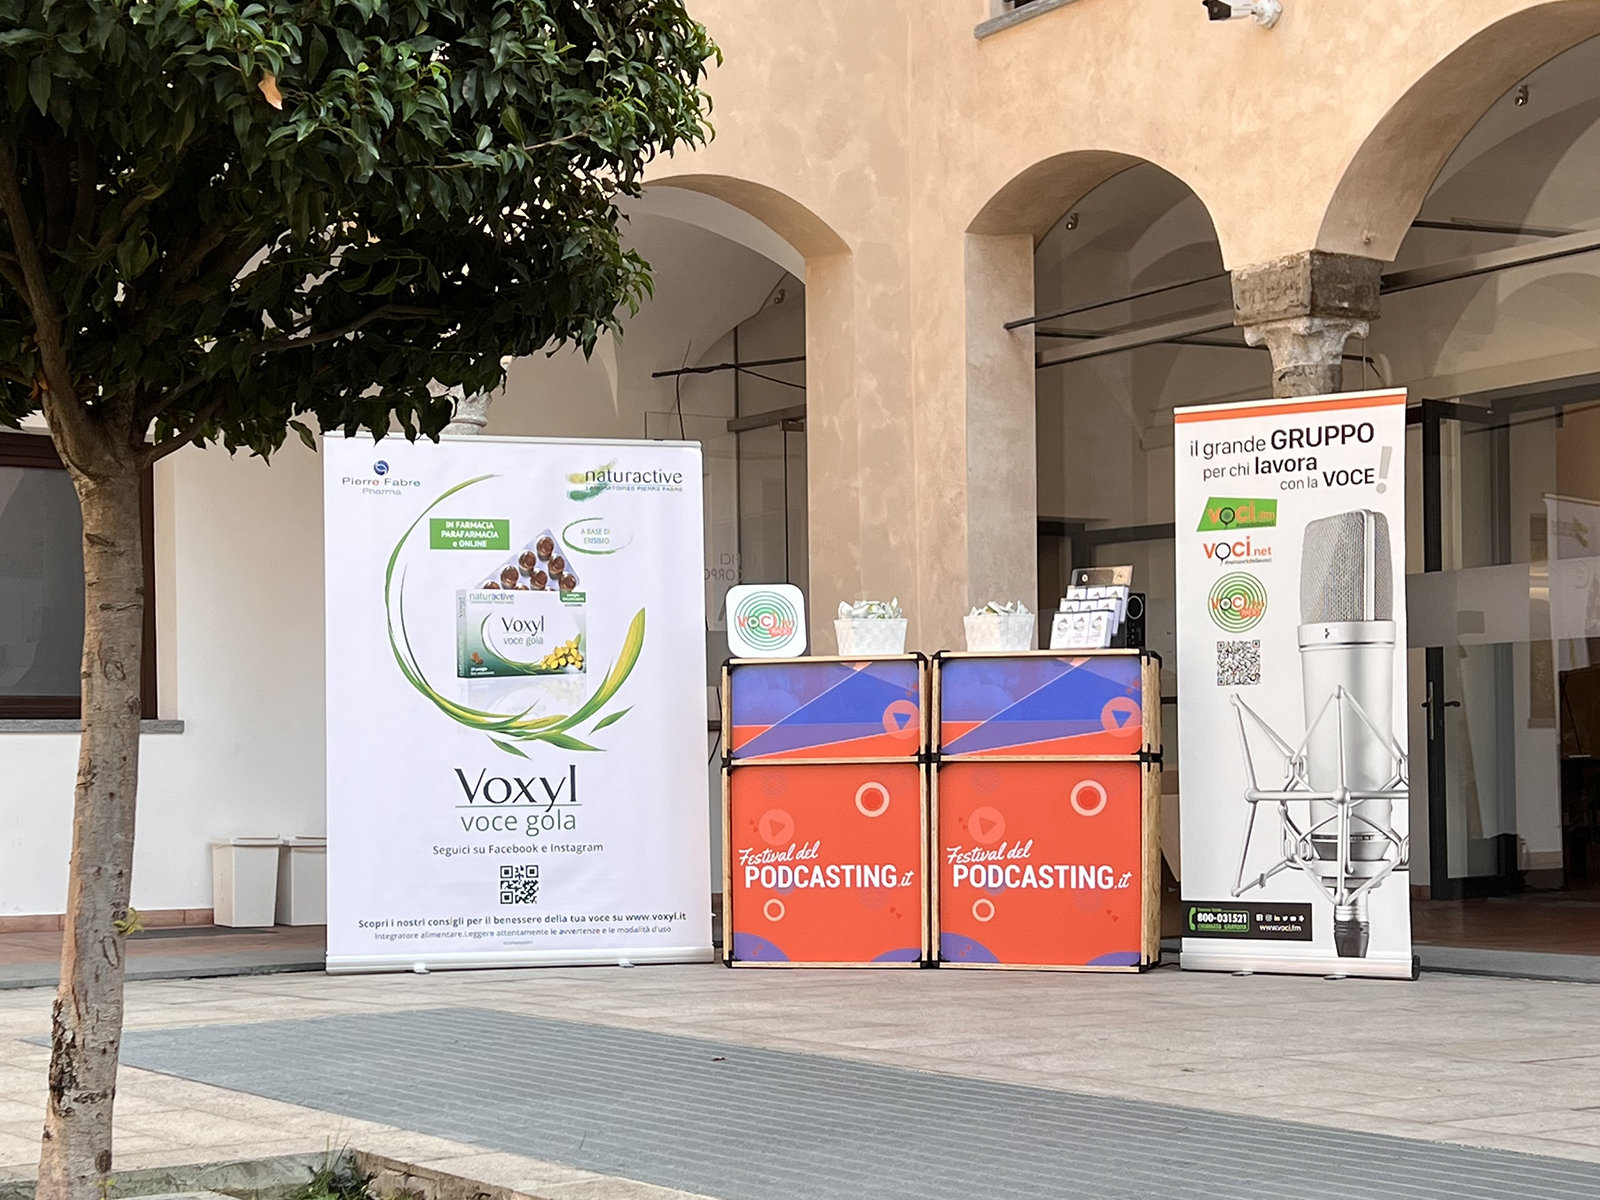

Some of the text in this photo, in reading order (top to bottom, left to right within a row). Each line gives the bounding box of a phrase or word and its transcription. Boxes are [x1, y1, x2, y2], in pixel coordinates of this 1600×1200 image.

[1190, 422, 1374, 460] il grande GRUPPO
[585, 468, 683, 484] naturactive
[1203, 456, 1317, 481] per chi lavora
[342, 477, 421, 487] Pierre Fabre
[1280, 478, 1304, 490] con
[1307, 476, 1318, 489] la
[362, 487, 402, 496] Pharma
[446, 521, 494, 530] IN FARMACIA
[441, 530, 499, 539] PARAFARMACIA
[459, 540, 487, 548] ONLINE
[469, 592, 515, 600] naturactive
[501, 615, 544, 636] Voxyl
[503, 636, 544, 647] voce gola
[454, 764, 577, 813] Voxyl
[461, 809, 576, 837] voce gola
[433, 845, 471, 857] Seguici
[473, 846, 485, 854] su
[489, 843, 539, 854] Facebook
[550, 843, 604, 855] Instagram
[738, 840, 821, 866] Festival del
[946, 839, 1034, 865] Festival del
[358, 919, 389, 929] Scopri
[397, 918, 426, 927] nostri
[428, 916, 465, 927] consigli
[467, 917, 483, 927] per
[485, 916, 491, 925] il
[494, 914, 542, 924] benessere
[544, 914, 568, 923] della
[589, 914, 610, 922] voce
[612, 914, 623, 922] su
[625, 911, 687, 923] www.voxyl.it
[1197, 912, 1247, 924] 800-031521
[375, 932, 419, 941] Integratore
[496, 928, 549, 937] attentamente
[550, 927, 557, 935] le
[558, 927, 601, 935] avvertenze
[608, 926, 616, 934] le
[652, 925, 672, 933] d'uso
